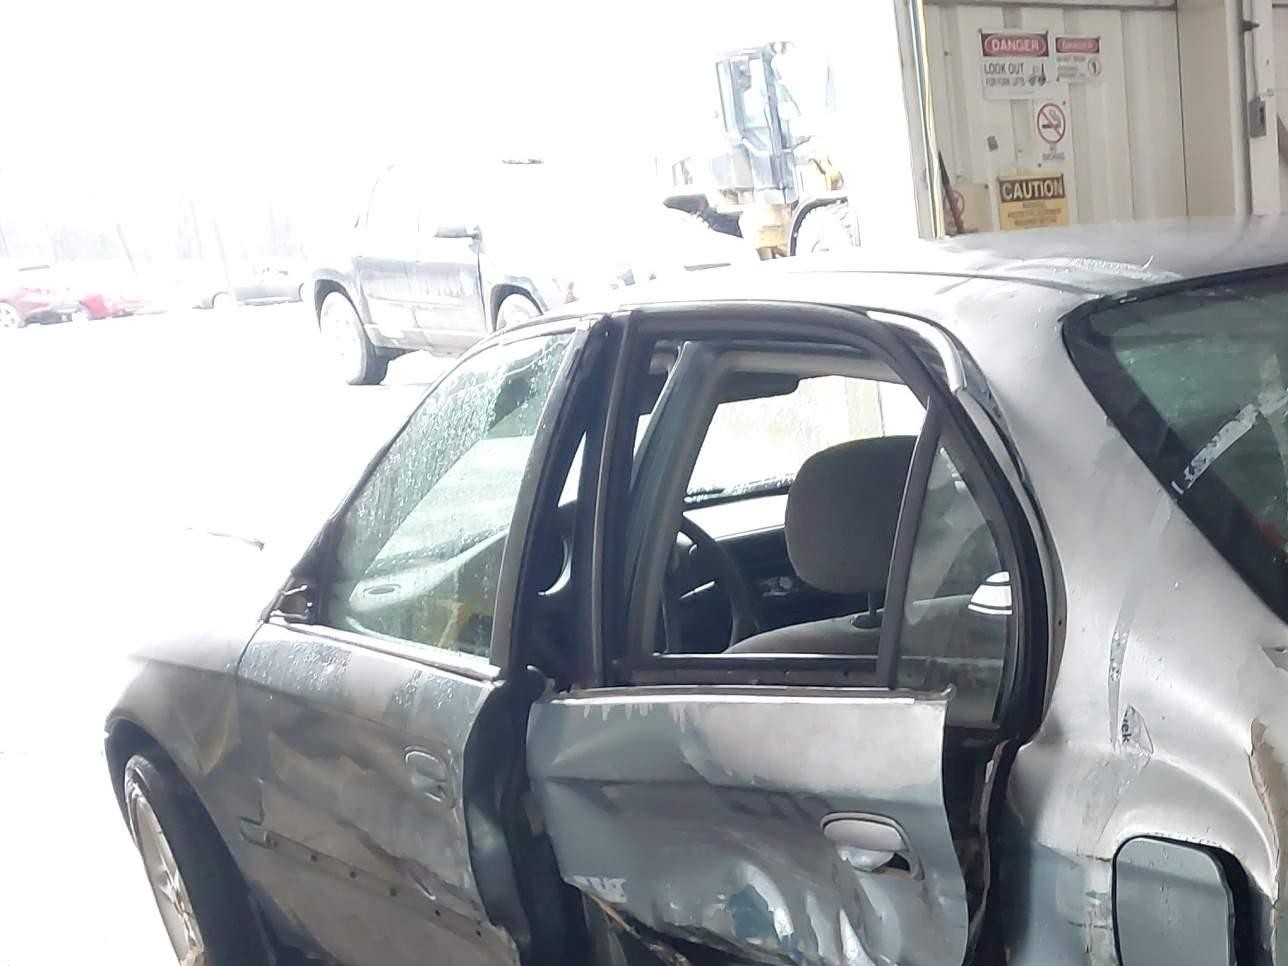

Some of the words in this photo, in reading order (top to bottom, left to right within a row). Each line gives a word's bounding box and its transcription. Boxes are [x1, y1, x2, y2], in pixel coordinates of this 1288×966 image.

[991, 39, 1040, 52] DANGER
[984, 62, 1006, 75] LOOK
[1008, 62, 1025, 75] OUT
[1002, 179, 1063, 200] CAUTION
